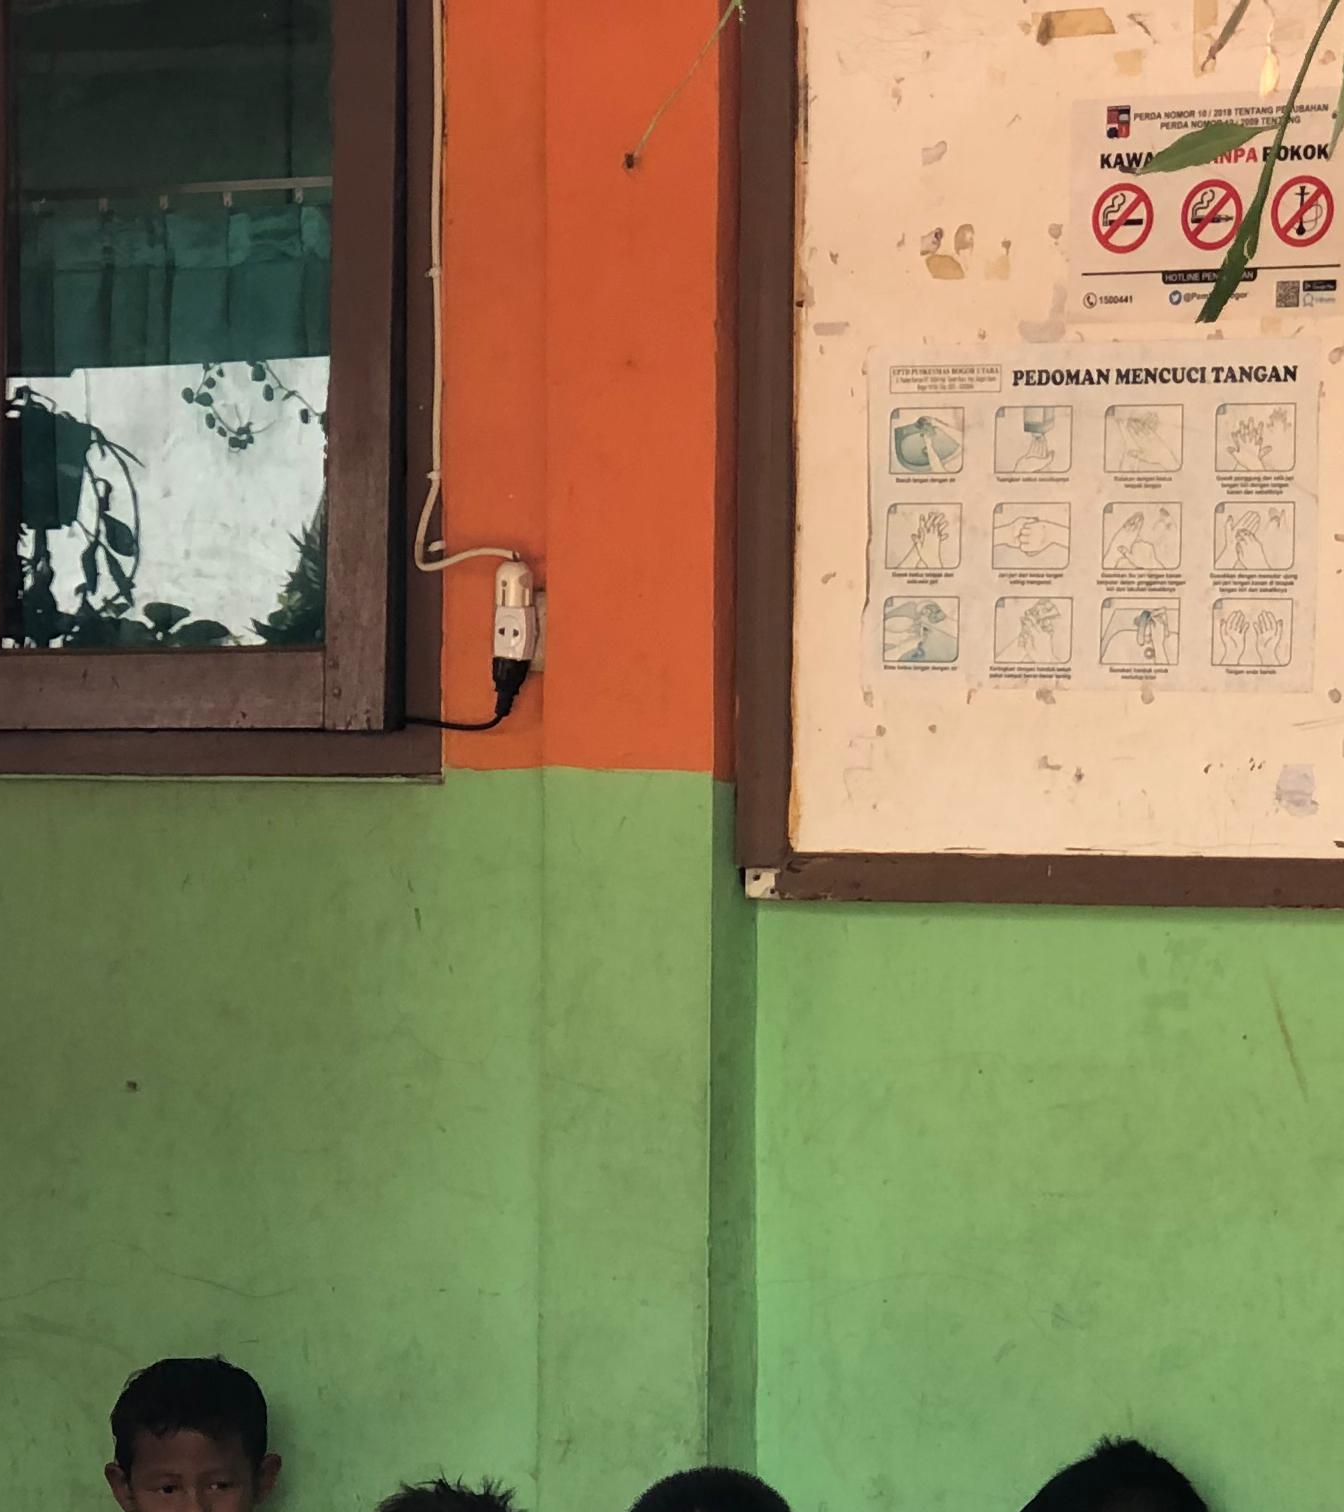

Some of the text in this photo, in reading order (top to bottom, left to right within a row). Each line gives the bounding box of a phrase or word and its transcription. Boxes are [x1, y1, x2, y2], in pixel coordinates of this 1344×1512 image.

[1133, 111, 1162, 121] PERDA
[1164, 109, 1196, 119] NOMOR
[1234, 106, 1274, 116] TENTANG
[1275, 103, 1329, 114] PEUBAHAN
[1160, 120, 1189, 130] PERDA
[1012, 367, 1111, 387] PEDOMAN
[1115, 366, 1207, 385] MENCUCI
[1211, 365, 1299, 384] TANGAN
